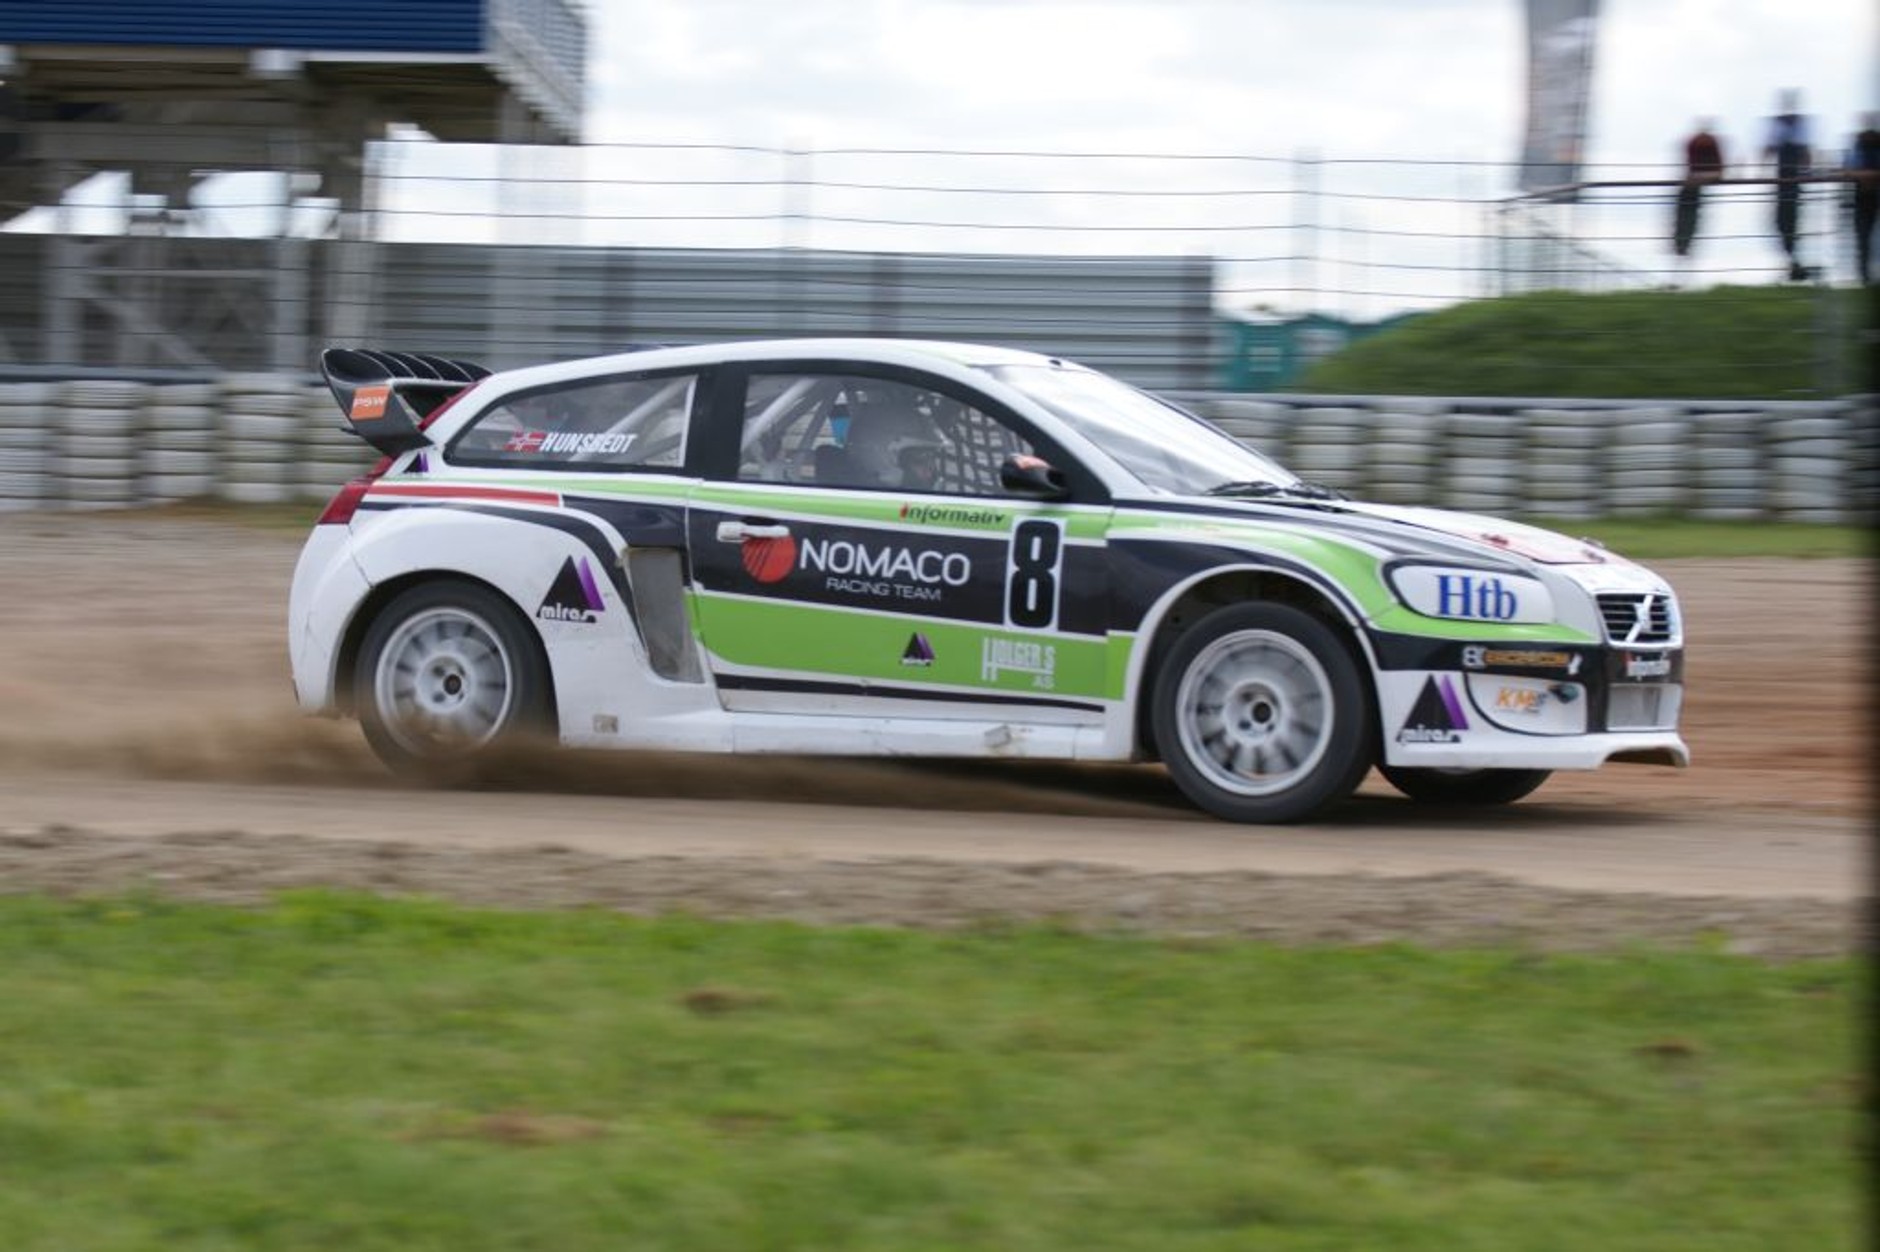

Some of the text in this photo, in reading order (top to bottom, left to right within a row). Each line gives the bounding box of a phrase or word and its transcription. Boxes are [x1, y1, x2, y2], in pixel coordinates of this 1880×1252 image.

[800, 538, 971, 586] NOMACO
[1008, 519, 1060, 628] 8
[826, 577, 942, 601] RACING TEAM
[1436, 575, 1517, 620] Htb
